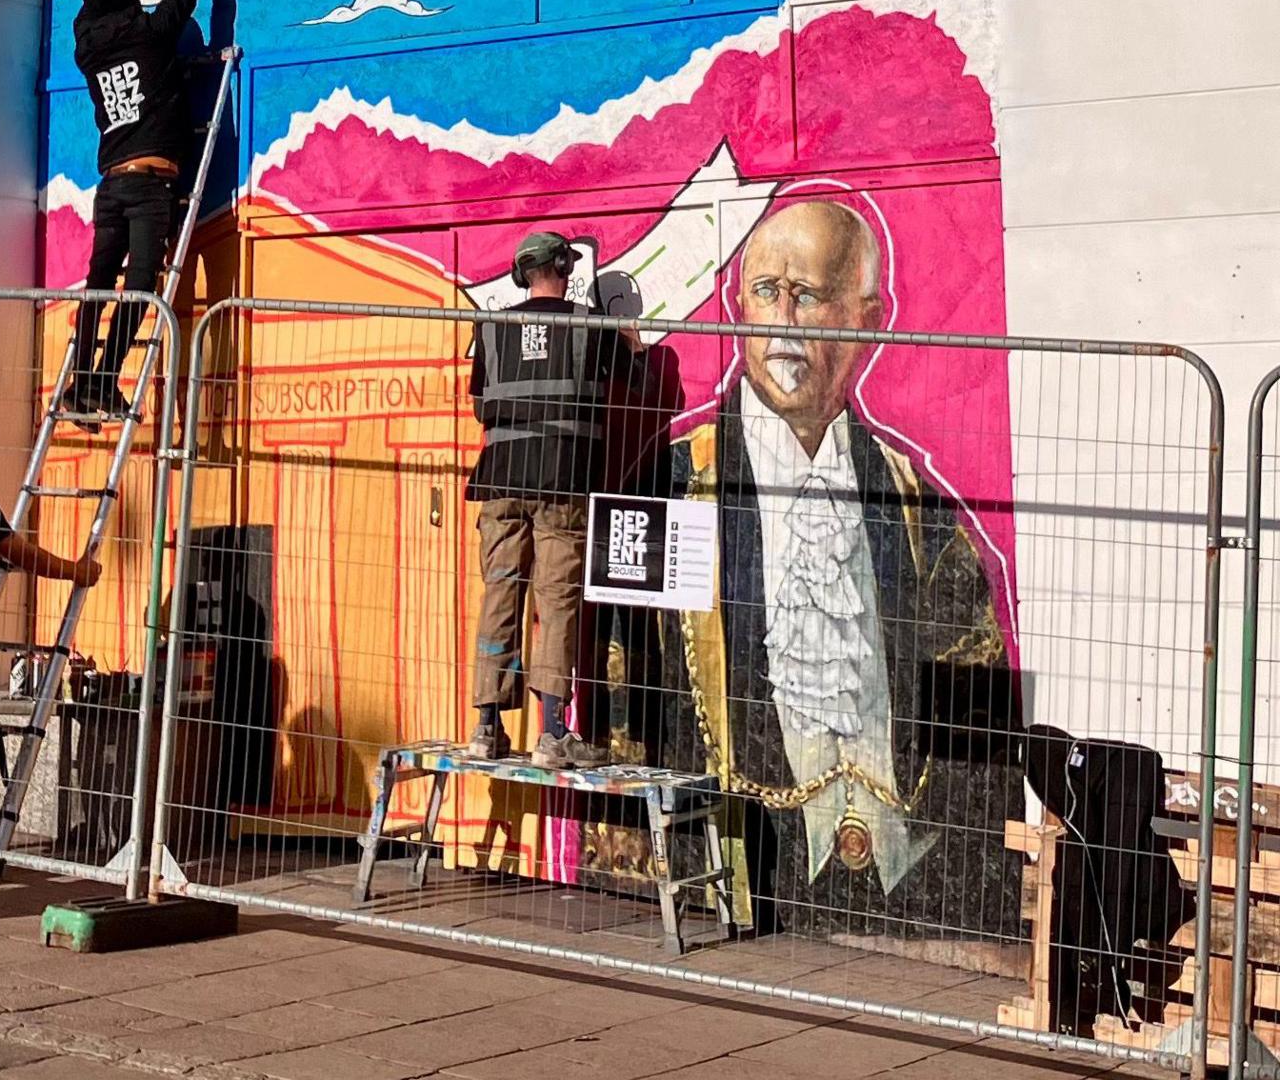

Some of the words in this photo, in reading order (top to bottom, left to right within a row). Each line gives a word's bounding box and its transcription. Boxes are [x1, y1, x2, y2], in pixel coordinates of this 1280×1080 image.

[254, 376, 425, 415] SUBSCRIPTION
[610, 509, 650, 529] REP
[608, 544, 647, 566] ENT
[608, 566, 646, 577] PROJECT
